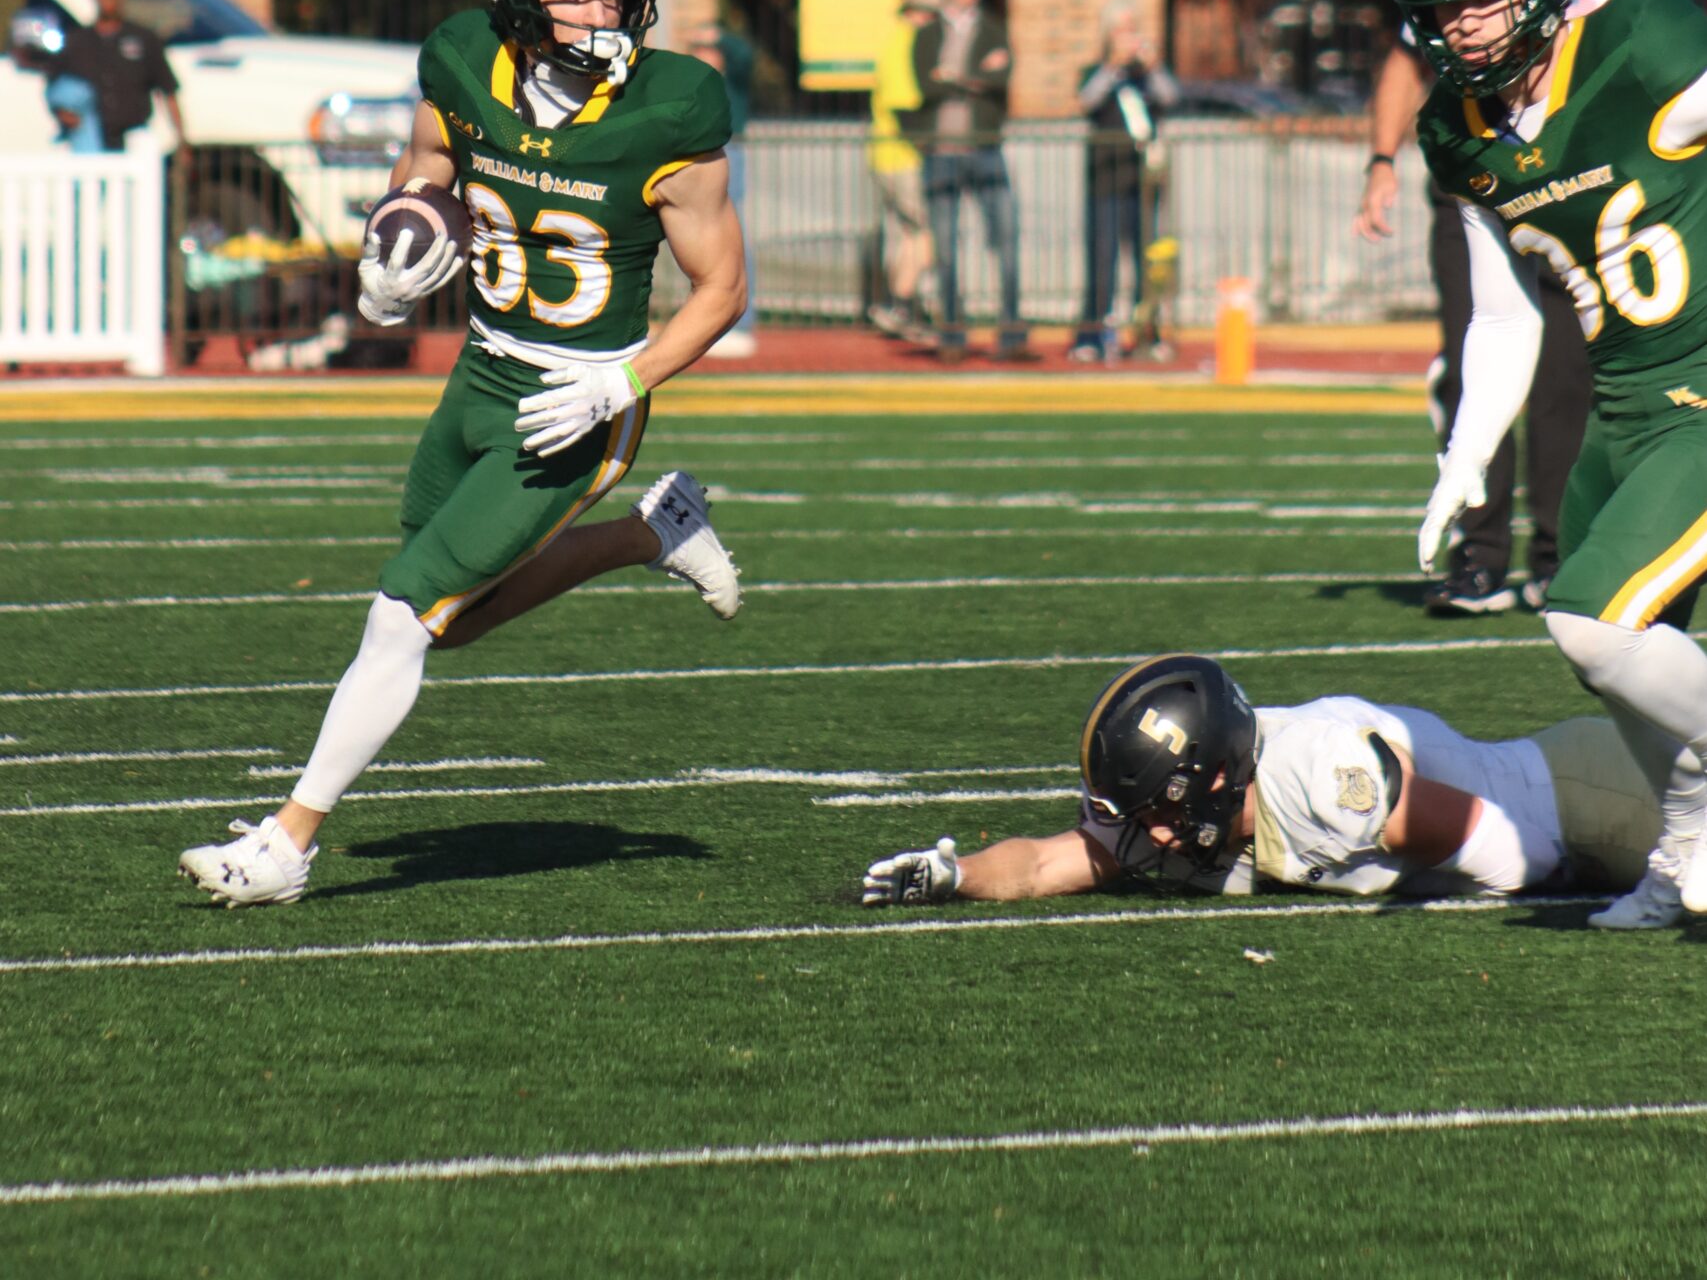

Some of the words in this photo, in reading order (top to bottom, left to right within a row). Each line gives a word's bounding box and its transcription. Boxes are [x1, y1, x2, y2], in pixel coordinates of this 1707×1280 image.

[470, 151, 537, 188] WILLIAM
[539, 171, 554, 193] &
[553, 176, 608, 202] MARY
[464, 182, 612, 328] 83
[1137, 707, 1188, 756] 5
